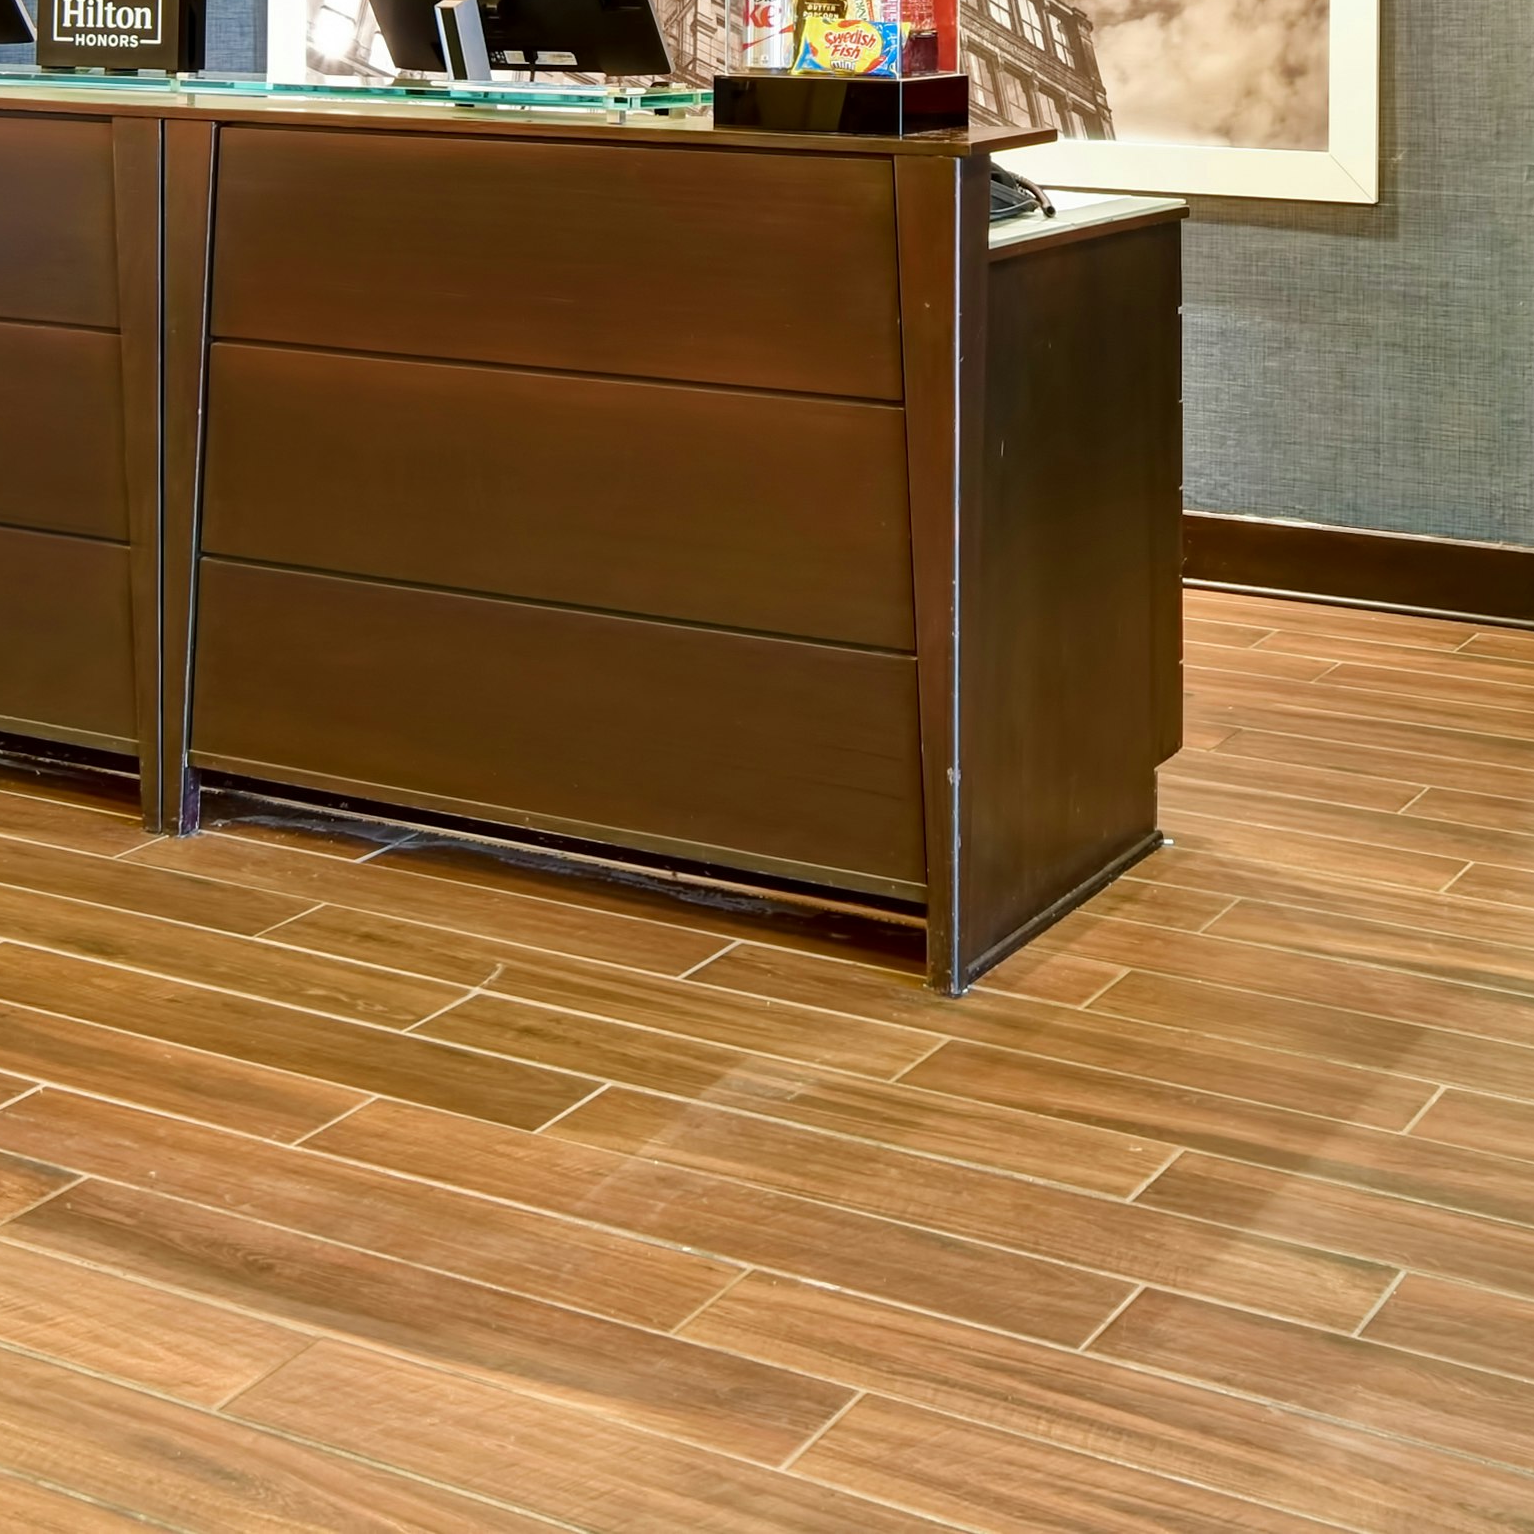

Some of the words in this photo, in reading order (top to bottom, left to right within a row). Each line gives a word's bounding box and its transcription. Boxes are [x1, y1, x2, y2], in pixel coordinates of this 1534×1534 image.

[75, 33, 140, 48] HONORS
[824, 29, 876, 48] Swedish
[831, 44, 861, 59] Fish
